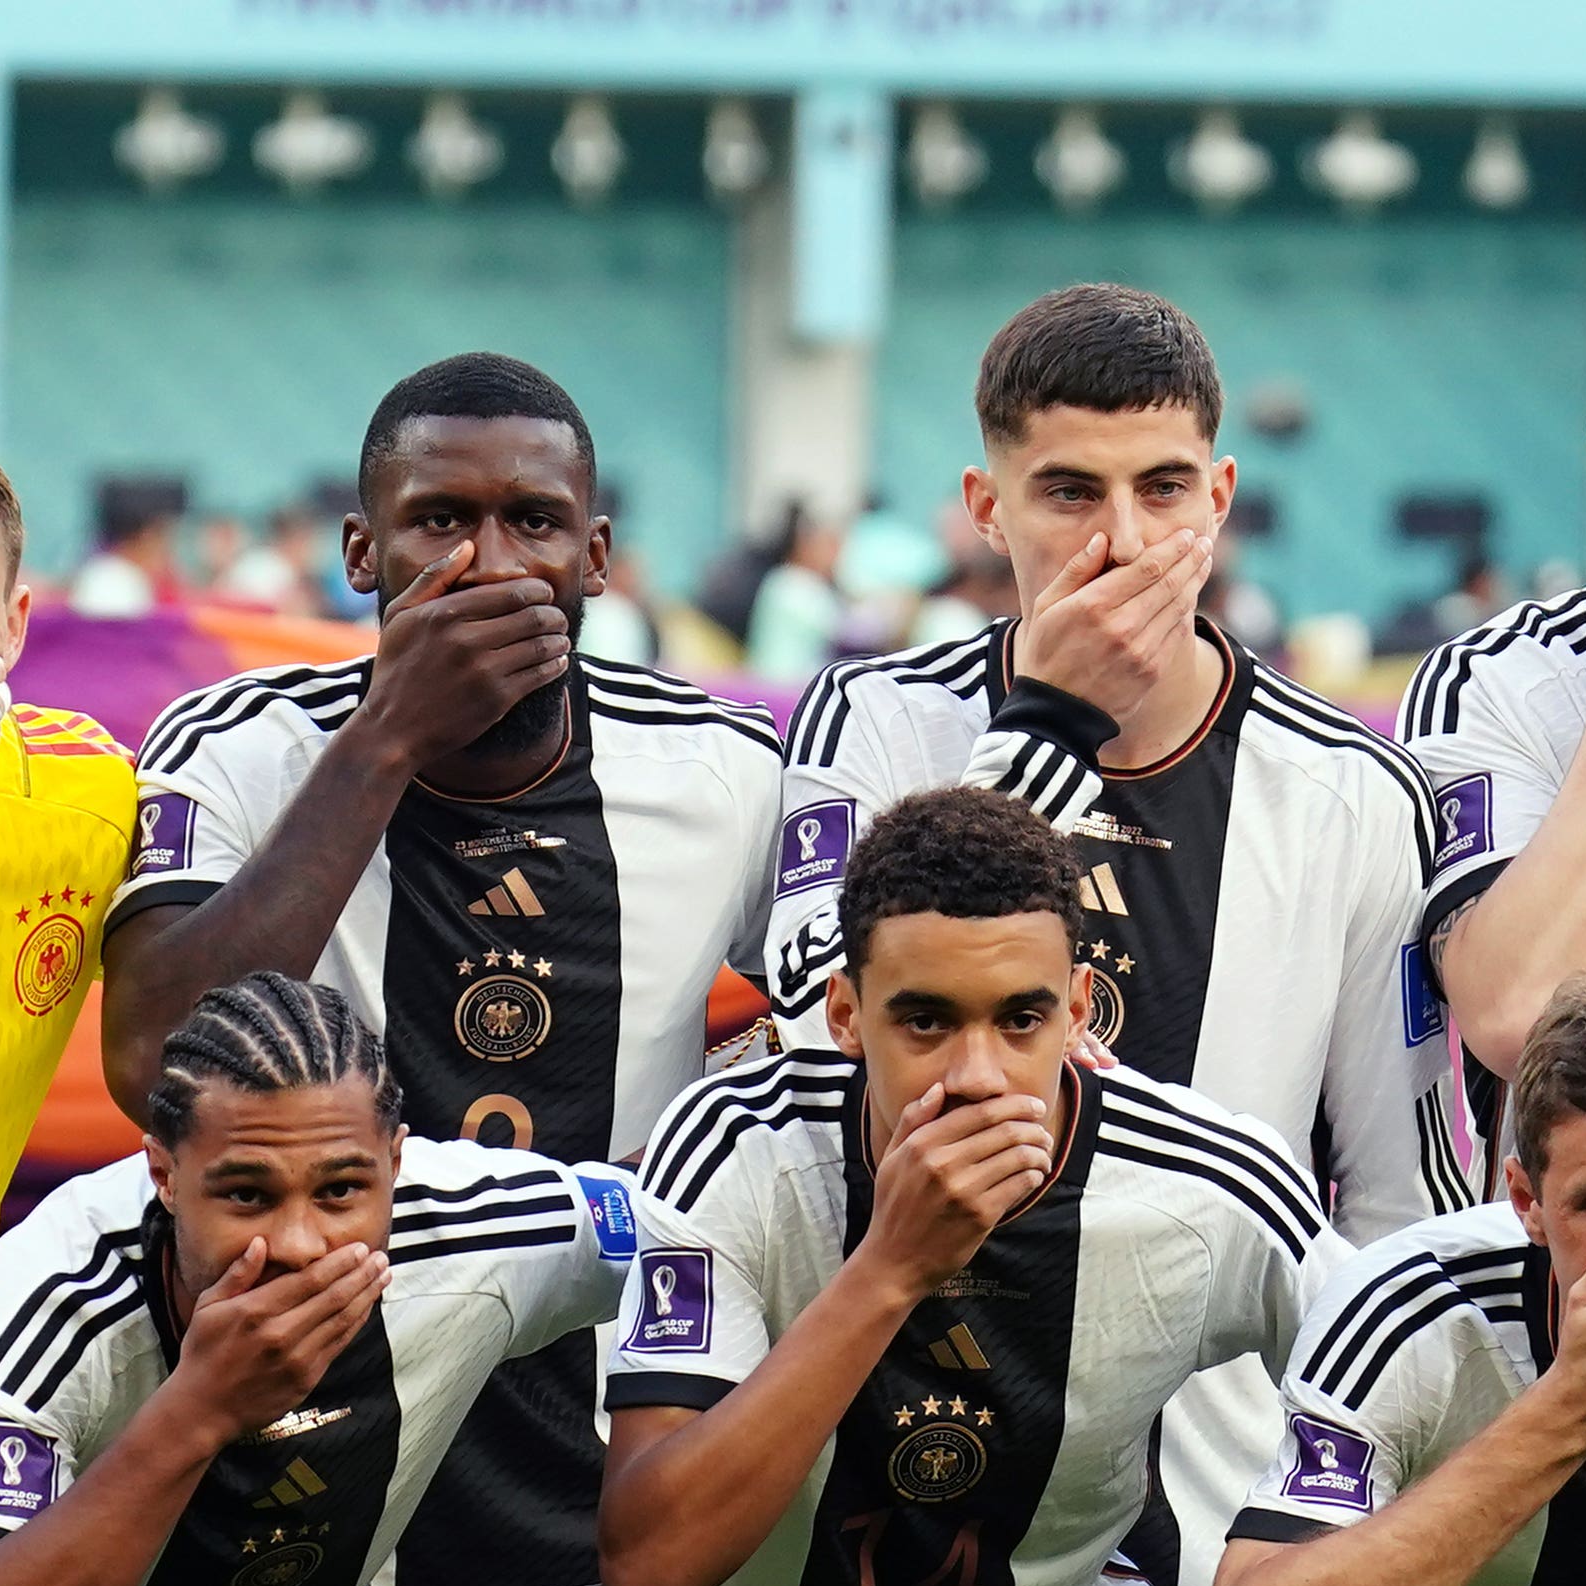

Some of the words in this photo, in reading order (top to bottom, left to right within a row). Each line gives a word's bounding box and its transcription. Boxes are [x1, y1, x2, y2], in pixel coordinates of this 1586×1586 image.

[1120, 825, 1142, 836] 2022
[454, 840, 467, 850] 23
[468, 834, 512, 848] NOVEMBER
[1134, 835, 1172, 850] STADIUM
[463, 842, 528, 858] INTERNATIONAL
[476, 985, 531, 1004] DEUTSCHER
[1344, 1477, 1359, 1486] CUP
[26, 1492, 42, 1500] CUP
